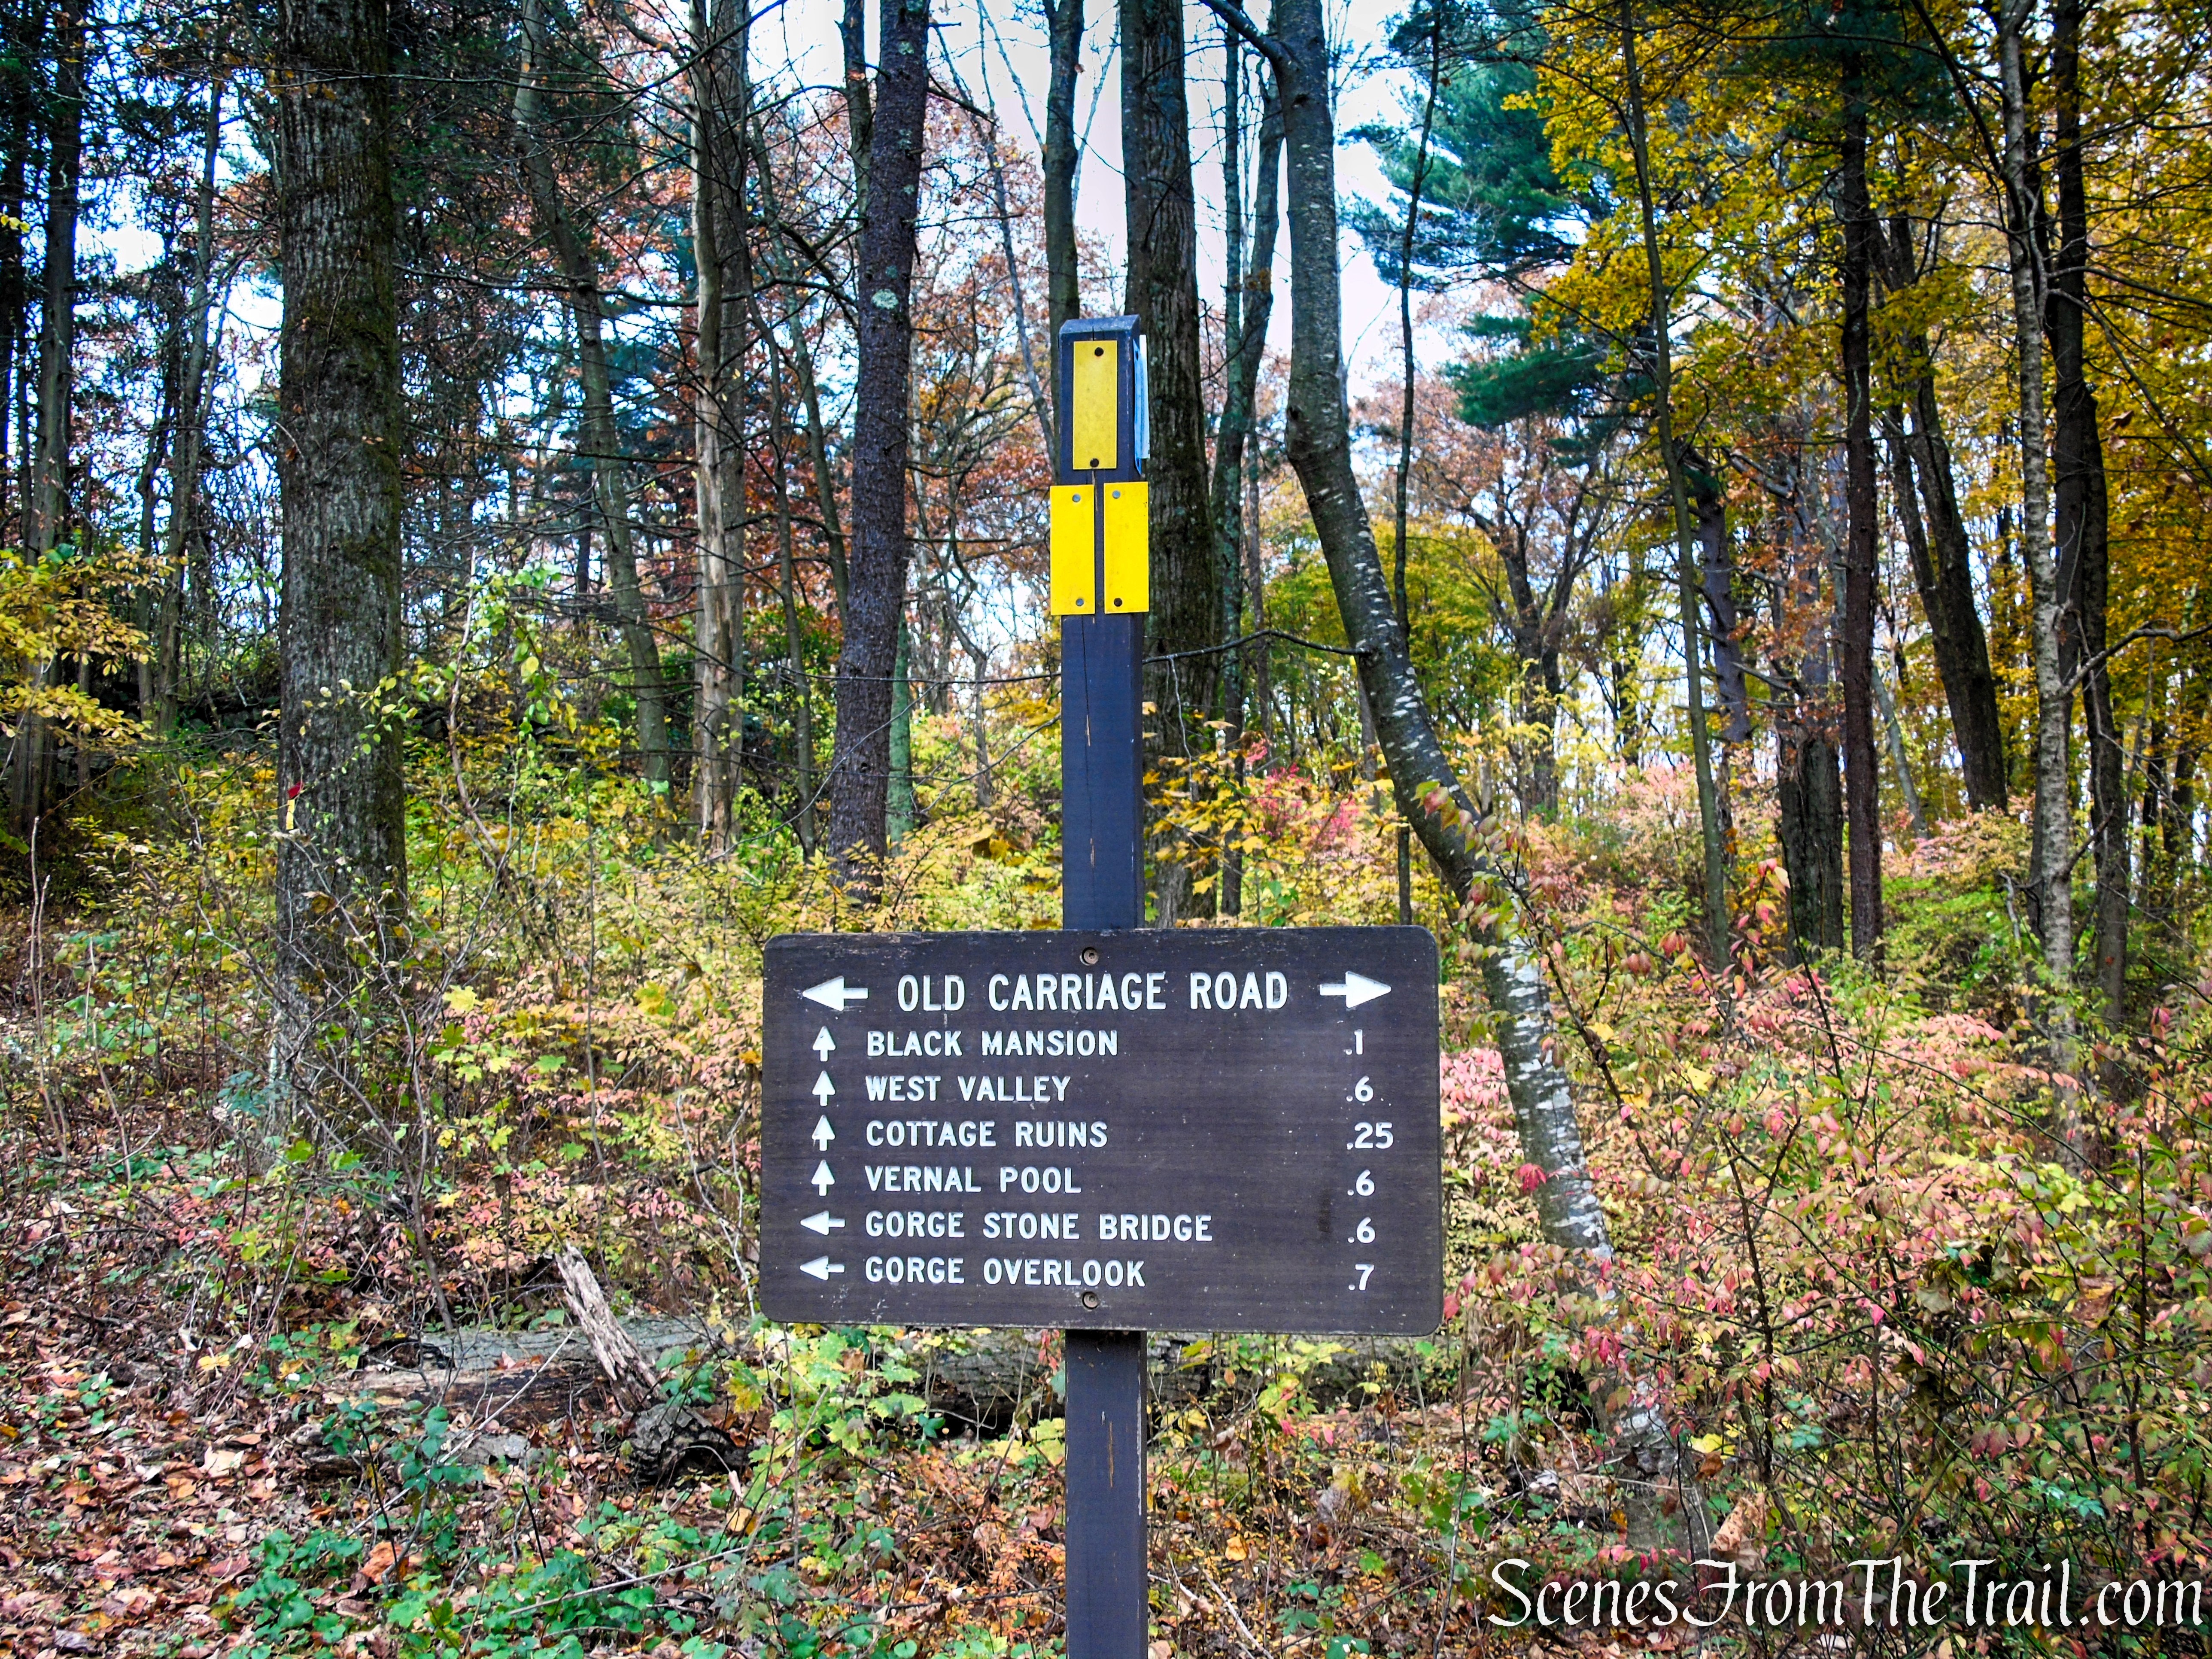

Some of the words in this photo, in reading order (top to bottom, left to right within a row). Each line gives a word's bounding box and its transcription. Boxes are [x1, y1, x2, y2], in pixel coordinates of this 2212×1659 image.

[896, 974, 966, 1012] OLD
[988, 972, 1167, 1012] CARRIAGE
[1189, 970, 1288, 1010] ROAD
[866, 1030, 963, 1057] BLACK
[981, 1029, 1118, 1057] MANSION
[1342, 1028, 1364, 1056] .1
[864, 1075, 942, 1102] WEST
[956, 1075, 1072, 1103] VALLEY
[1345, 1074, 1374, 1103] .6
[865, 1119, 997, 1148] COTTAGE
[1015, 1120, 1108, 1148] RUINS
[1346, 1121, 1395, 1151] .25
[864, 1164, 982, 1193] VERNAL
[999, 1166, 1082, 1194] POOL
[1346, 1168, 1376, 1197] .6
[865, 1209, 966, 1239] GORGE
[982, 1211, 1081, 1240] STONE
[1098, 1212, 1213, 1242] BRIDGE
[1347, 1216, 1376, 1244] .6
[864, 1255, 965, 1285] GORGE
[982, 1257, 1146, 1288] OVERLOOK
[1347, 1263, 1375, 1292] .7
